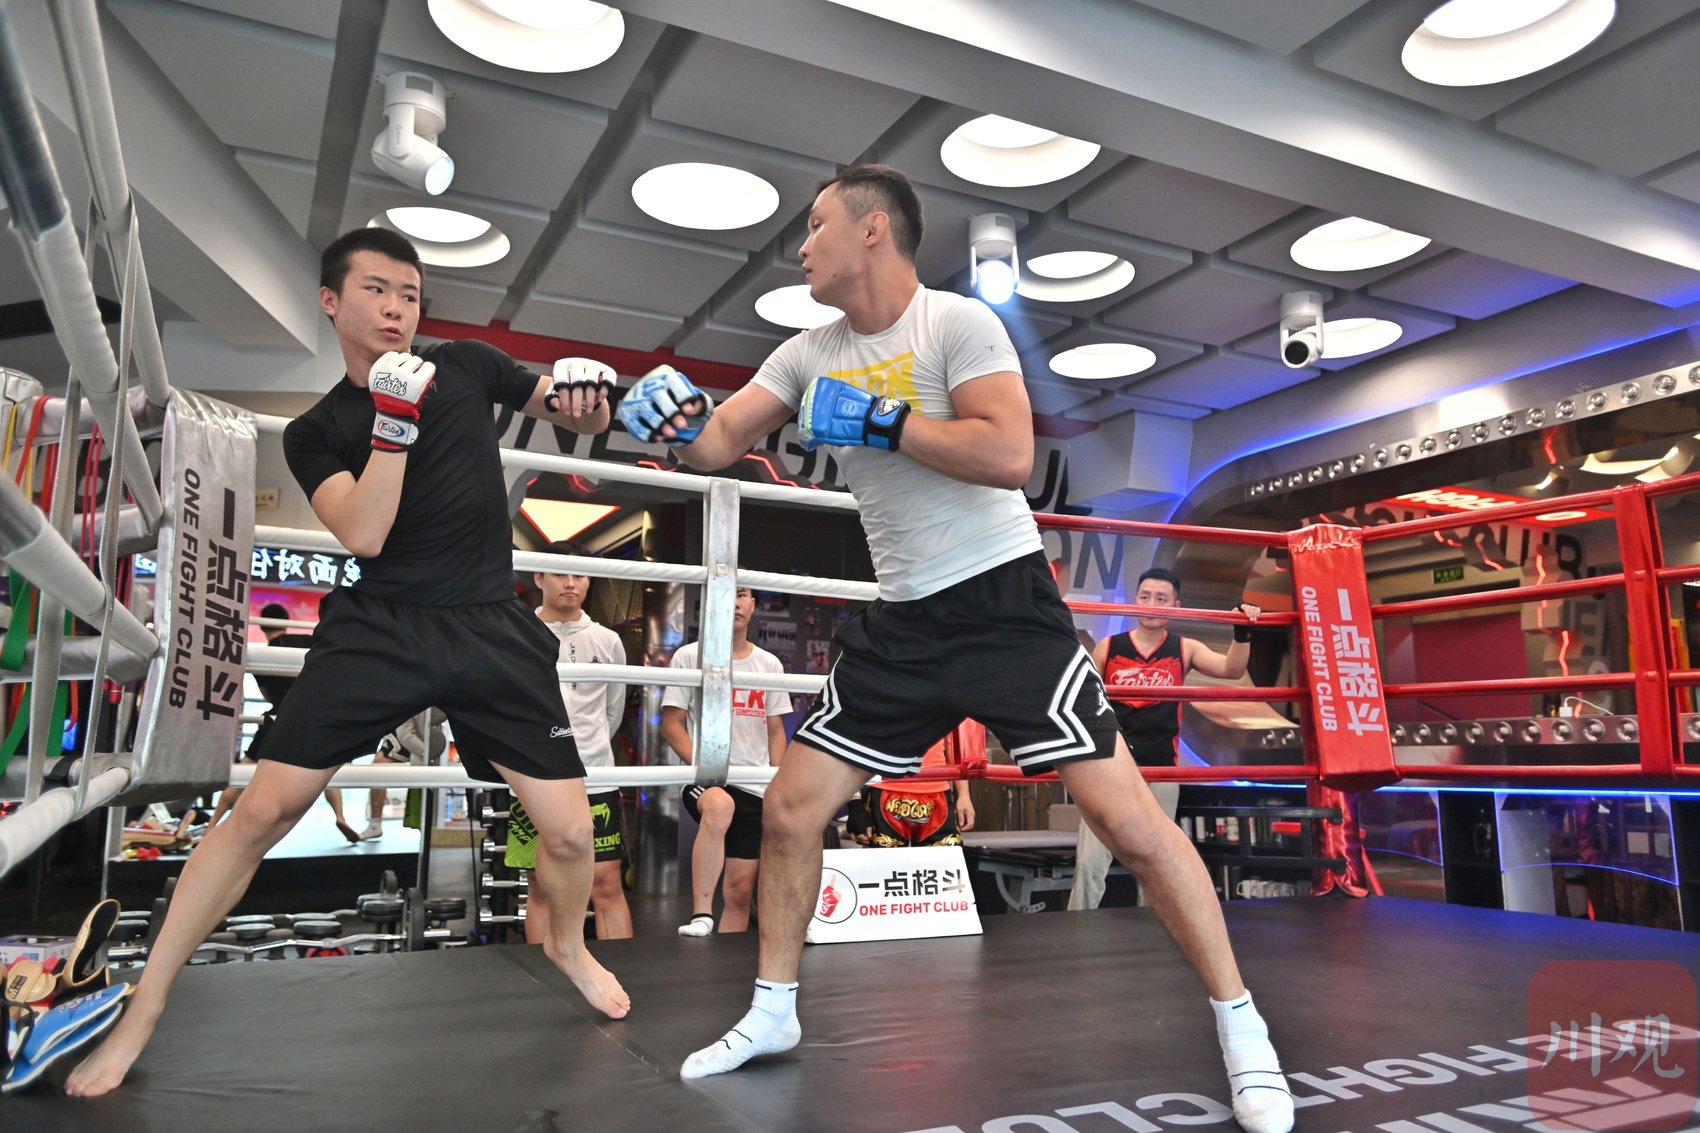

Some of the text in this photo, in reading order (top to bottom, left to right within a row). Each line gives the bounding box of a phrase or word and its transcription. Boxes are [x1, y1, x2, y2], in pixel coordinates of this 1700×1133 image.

[374, 372, 407, 396] Fairtex
[169, 468, 200, 709] ONE FIGHT CLUB
[196, 487, 247, 721] 一点格斗
[1301, 586, 1338, 732] ONE FIGHT CLUB
[1331, 588, 1384, 736] 一点格斗
[594, 832, 621, 848] XING
[858, 869, 966, 898] 一点格斗
[859, 901, 969, 917] ONE FIGHT CLUB
[902, 1092, 1235, 1133] CLU
